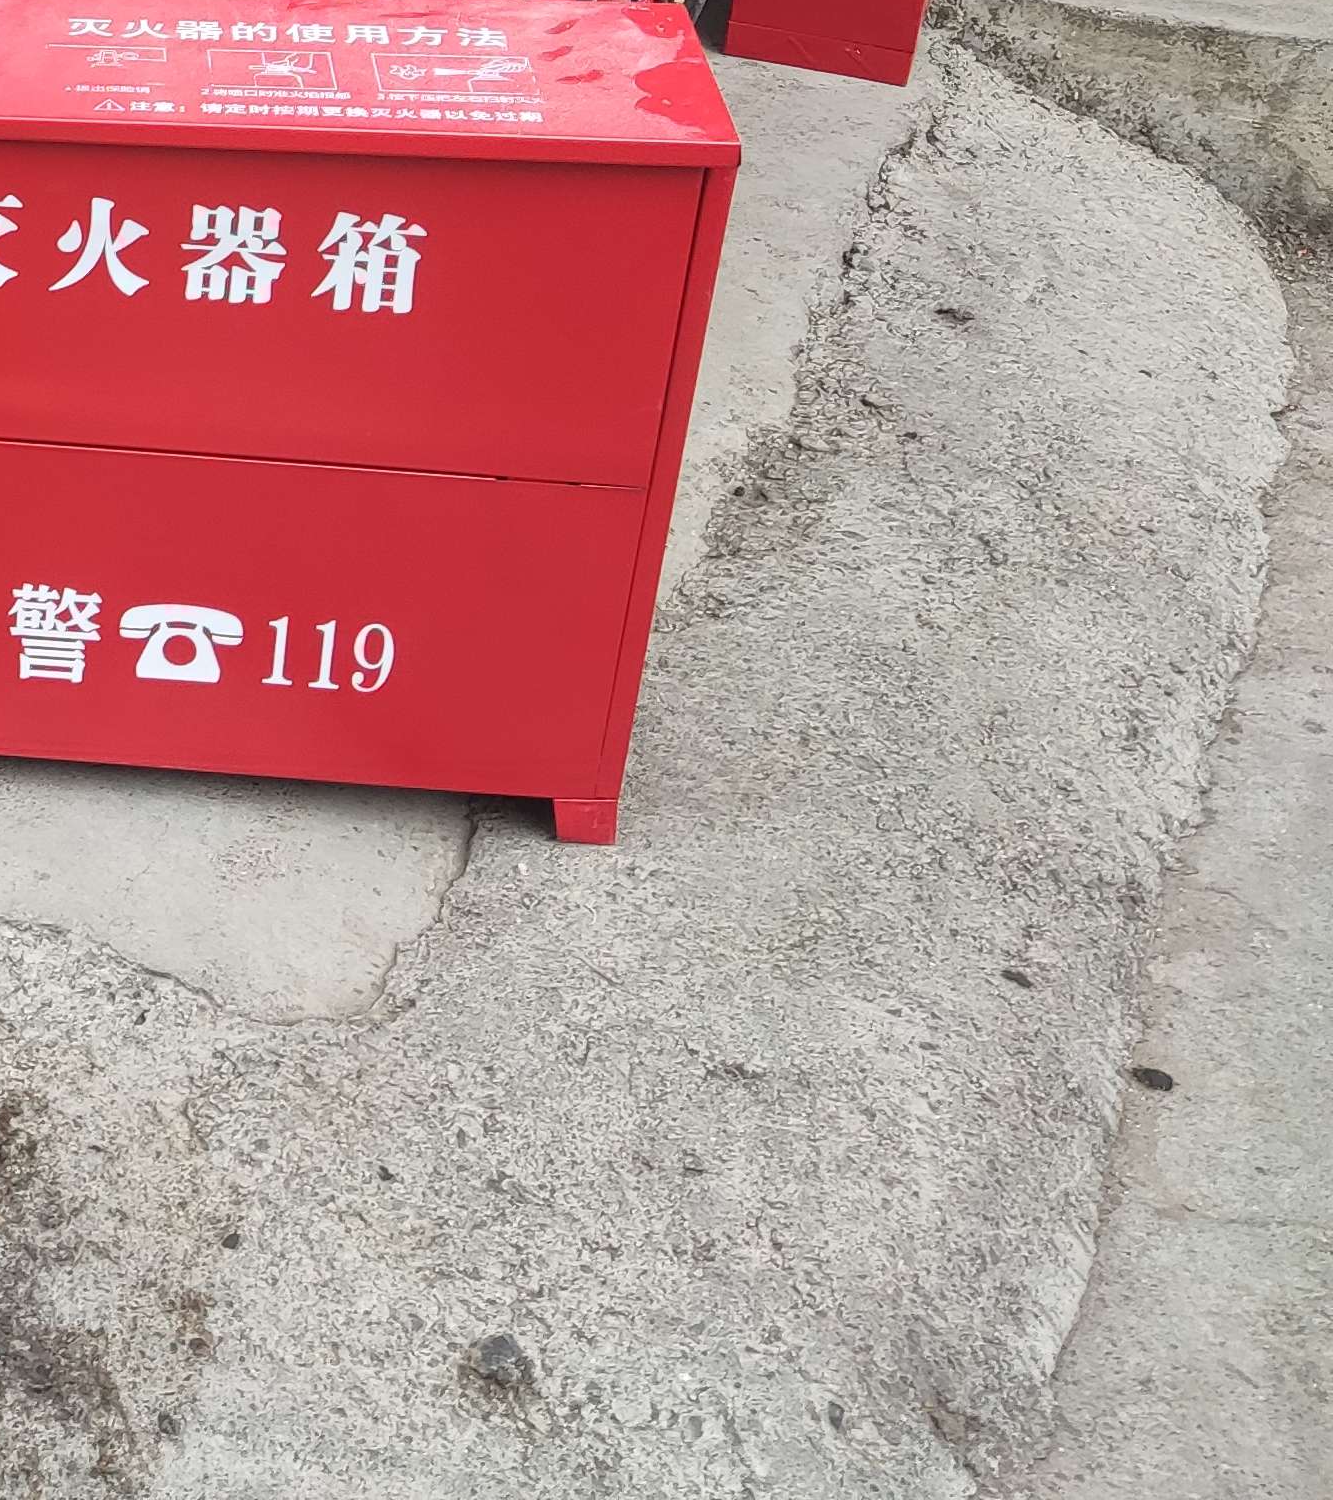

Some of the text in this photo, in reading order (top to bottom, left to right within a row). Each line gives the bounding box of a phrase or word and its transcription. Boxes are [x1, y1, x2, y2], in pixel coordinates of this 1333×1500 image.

[67, 16, 508, 51] 灭火器的使用方法
[261, 614, 397, 693] 119
